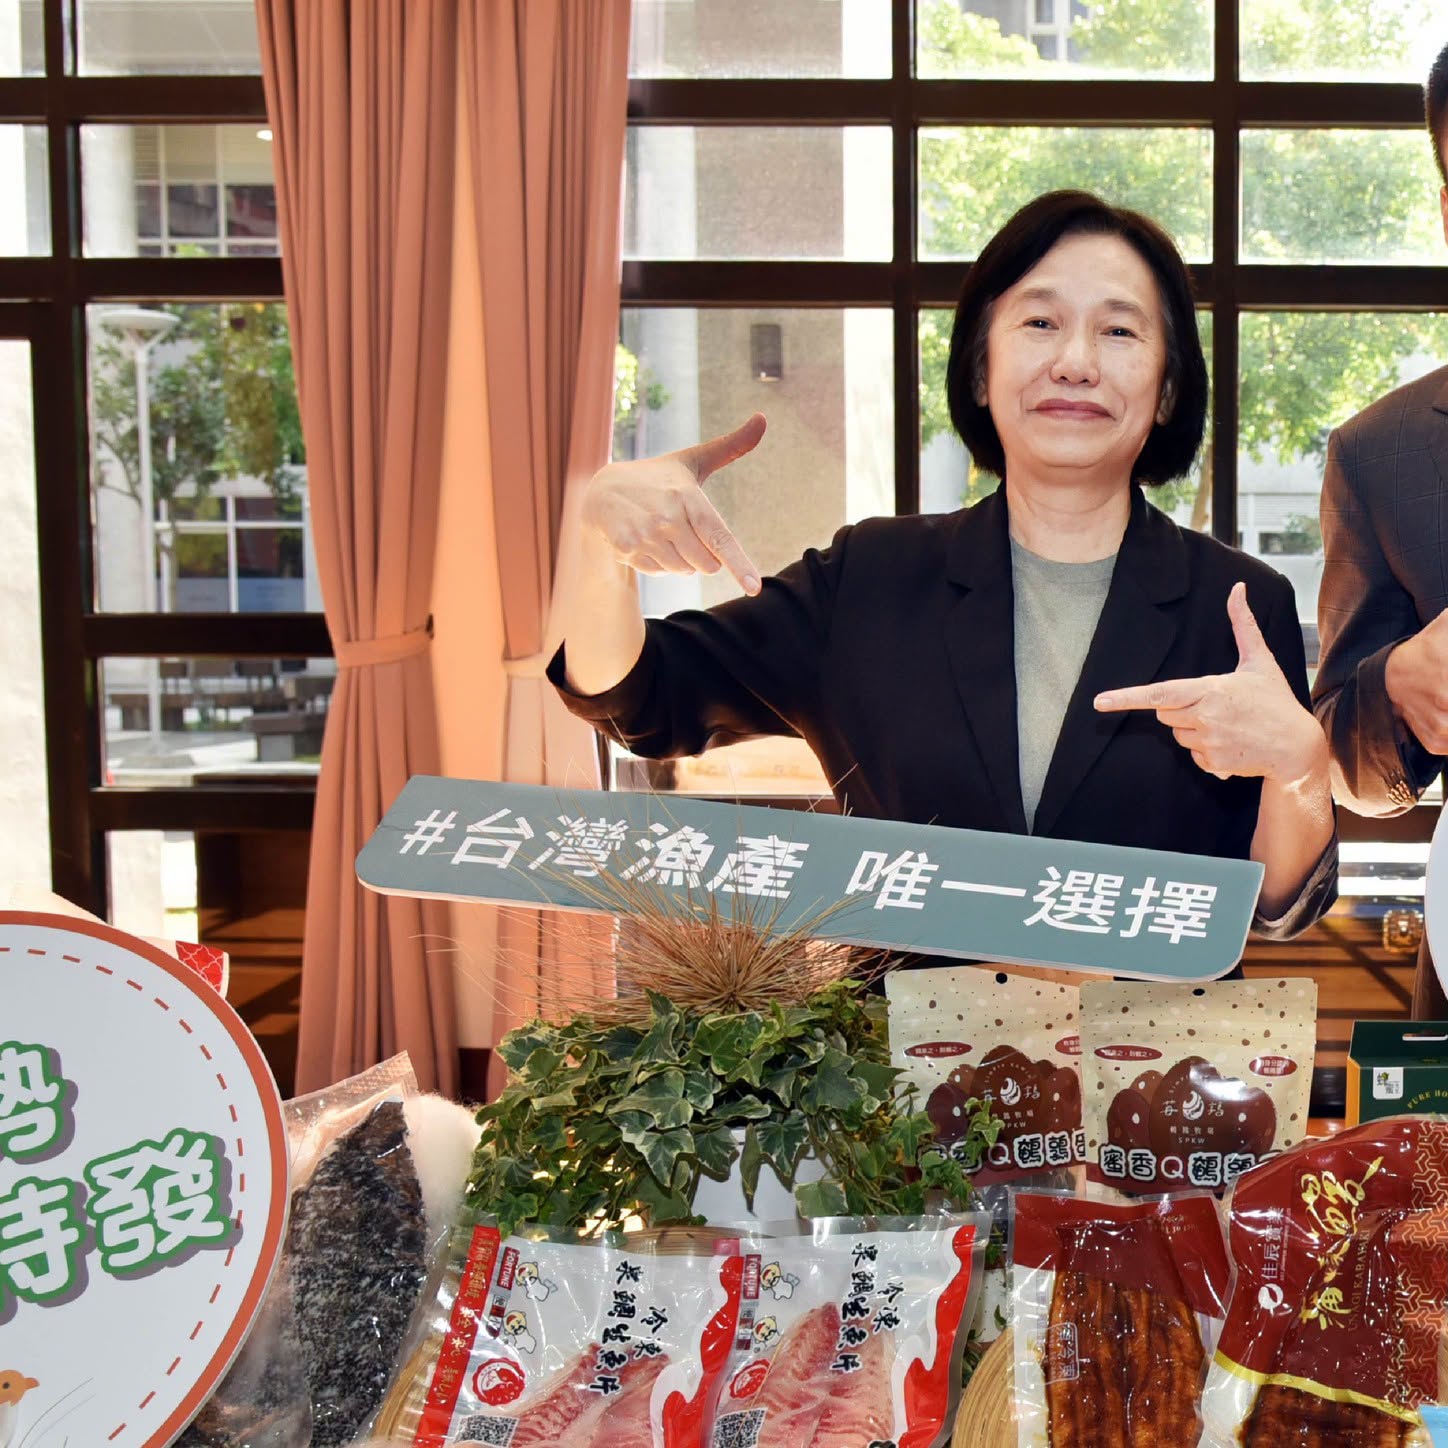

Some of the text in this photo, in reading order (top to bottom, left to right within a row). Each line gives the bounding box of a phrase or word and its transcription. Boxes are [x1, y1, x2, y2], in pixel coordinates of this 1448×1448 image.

[399, 808, 1218, 945] #台灣漁產 唯一選擇
[1406, 1091, 1431, 1109] PURE
[499, 1249, 520, 1290] FORTUNE
